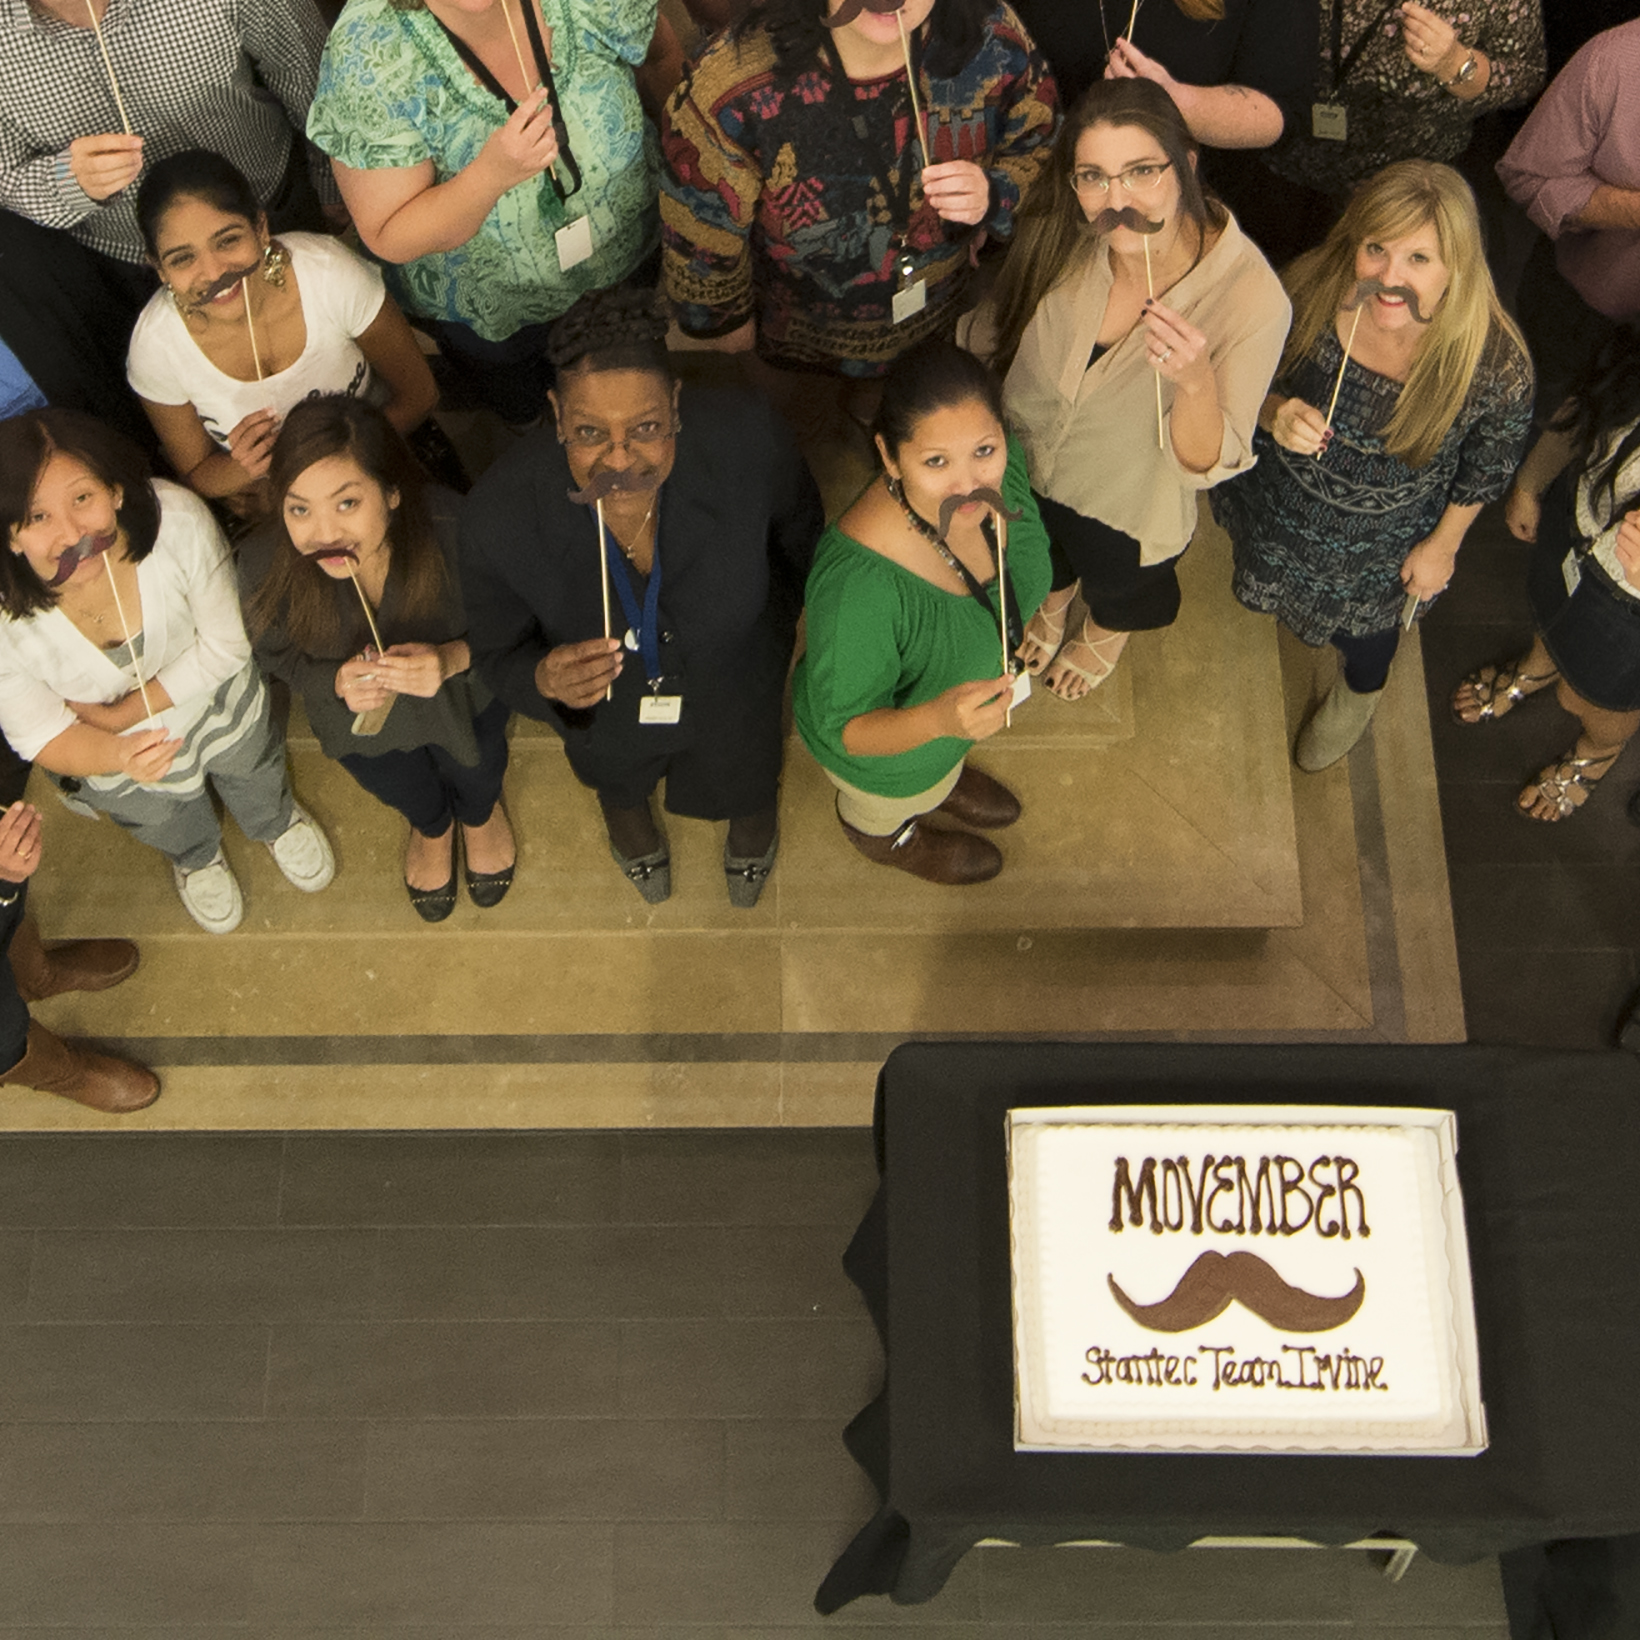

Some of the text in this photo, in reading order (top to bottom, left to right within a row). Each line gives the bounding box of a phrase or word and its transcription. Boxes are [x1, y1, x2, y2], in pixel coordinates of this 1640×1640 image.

[1108, 1154, 1371, 1240] MOVEMBER
[1081, 1344, 1389, 1392] Stantec Team Irvine
